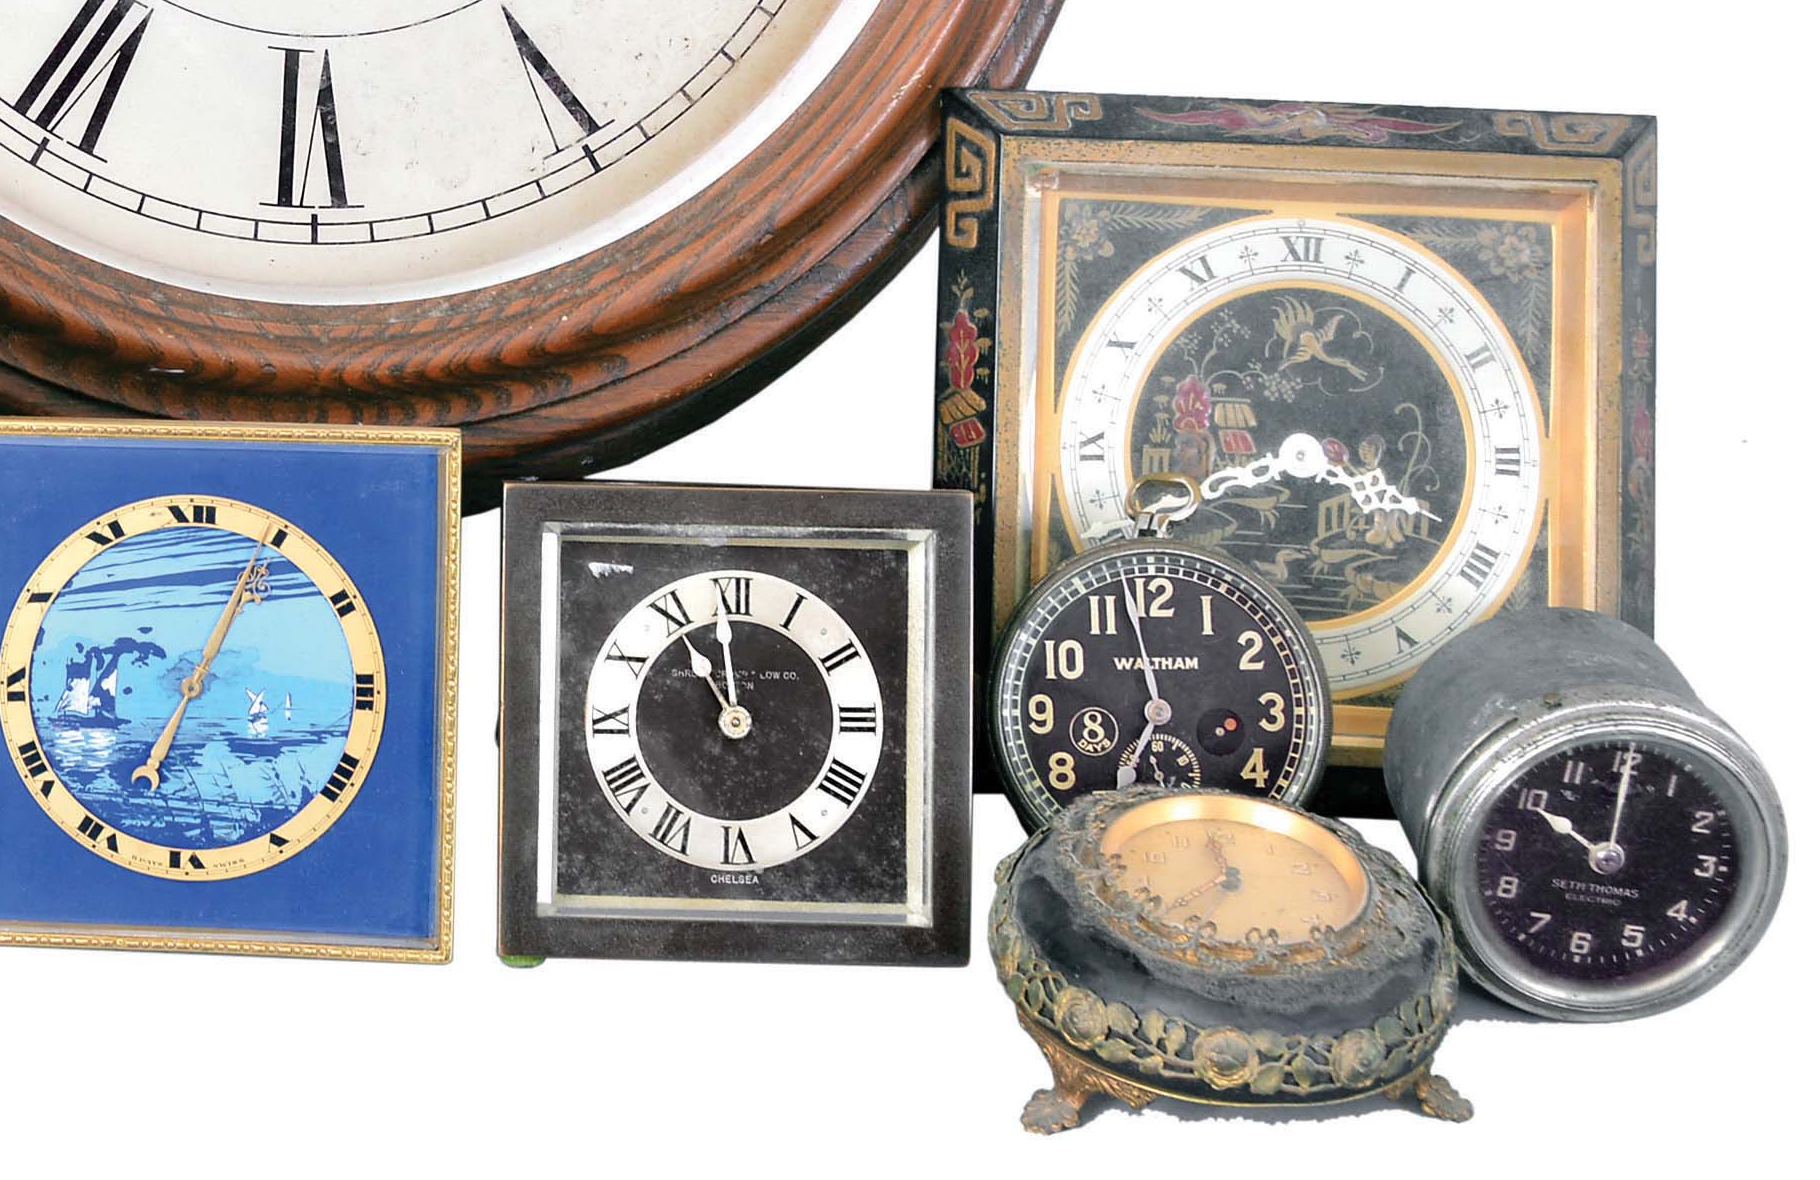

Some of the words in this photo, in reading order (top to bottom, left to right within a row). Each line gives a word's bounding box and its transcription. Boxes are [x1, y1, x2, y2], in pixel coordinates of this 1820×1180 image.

[500, 3, 615, 155] V
[260, 46, 365, 210] VI
[648, 588, 694, 638] XI
[1134, 577, 1176, 618] 12
[604, 640, 650, 679] X
[818, 638, 862, 676] II
[1043, 639, 1085, 680] 10
[1113, 657, 1199, 670] WALTHAM
[1237, 630, 1265, 670] 2
[760, 670, 780, 680] LOW
[783, 671, 800, 680] CO.
[591, 704, 631, 738] IX
[838, 704, 877, 736] III
[1028, 694, 1054, 735] 9
[1082, 710, 1106, 743] 8
[1258, 692, 1286, 732] 3
[1077, 738, 1111, 752] DAYS
[1151, 740, 1164, 753] 60
[816, 757, 868, 809] IIII
[1048, 751, 1076, 791] 8
[1240, 748, 1269, 788] 4
[1563, 760, 1584, 785] 11
[602, 754, 652, 816] VIII
[1517, 788, 1548, 811] 10
[648, 802, 692, 857] VII
[788, 813, 820, 851] V
[1691, 811, 1715, 834] 2
[720, 825, 757, 865] VI
[1494, 830, 1517, 852] 9
[710, 874, 759, 886] CHELSEA
[1694, 855, 1717, 878] 3
[1496, 875, 1519, 899] 8
[1551, 878, 1586, 891] SETH
[1589, 883, 1640, 899] THOMAS
[1529, 911, 1551, 934] 7
[1666, 899, 1688, 922] 4
[1570, 932, 1591, 955] 6
[1620, 925, 1645, 948] 5
